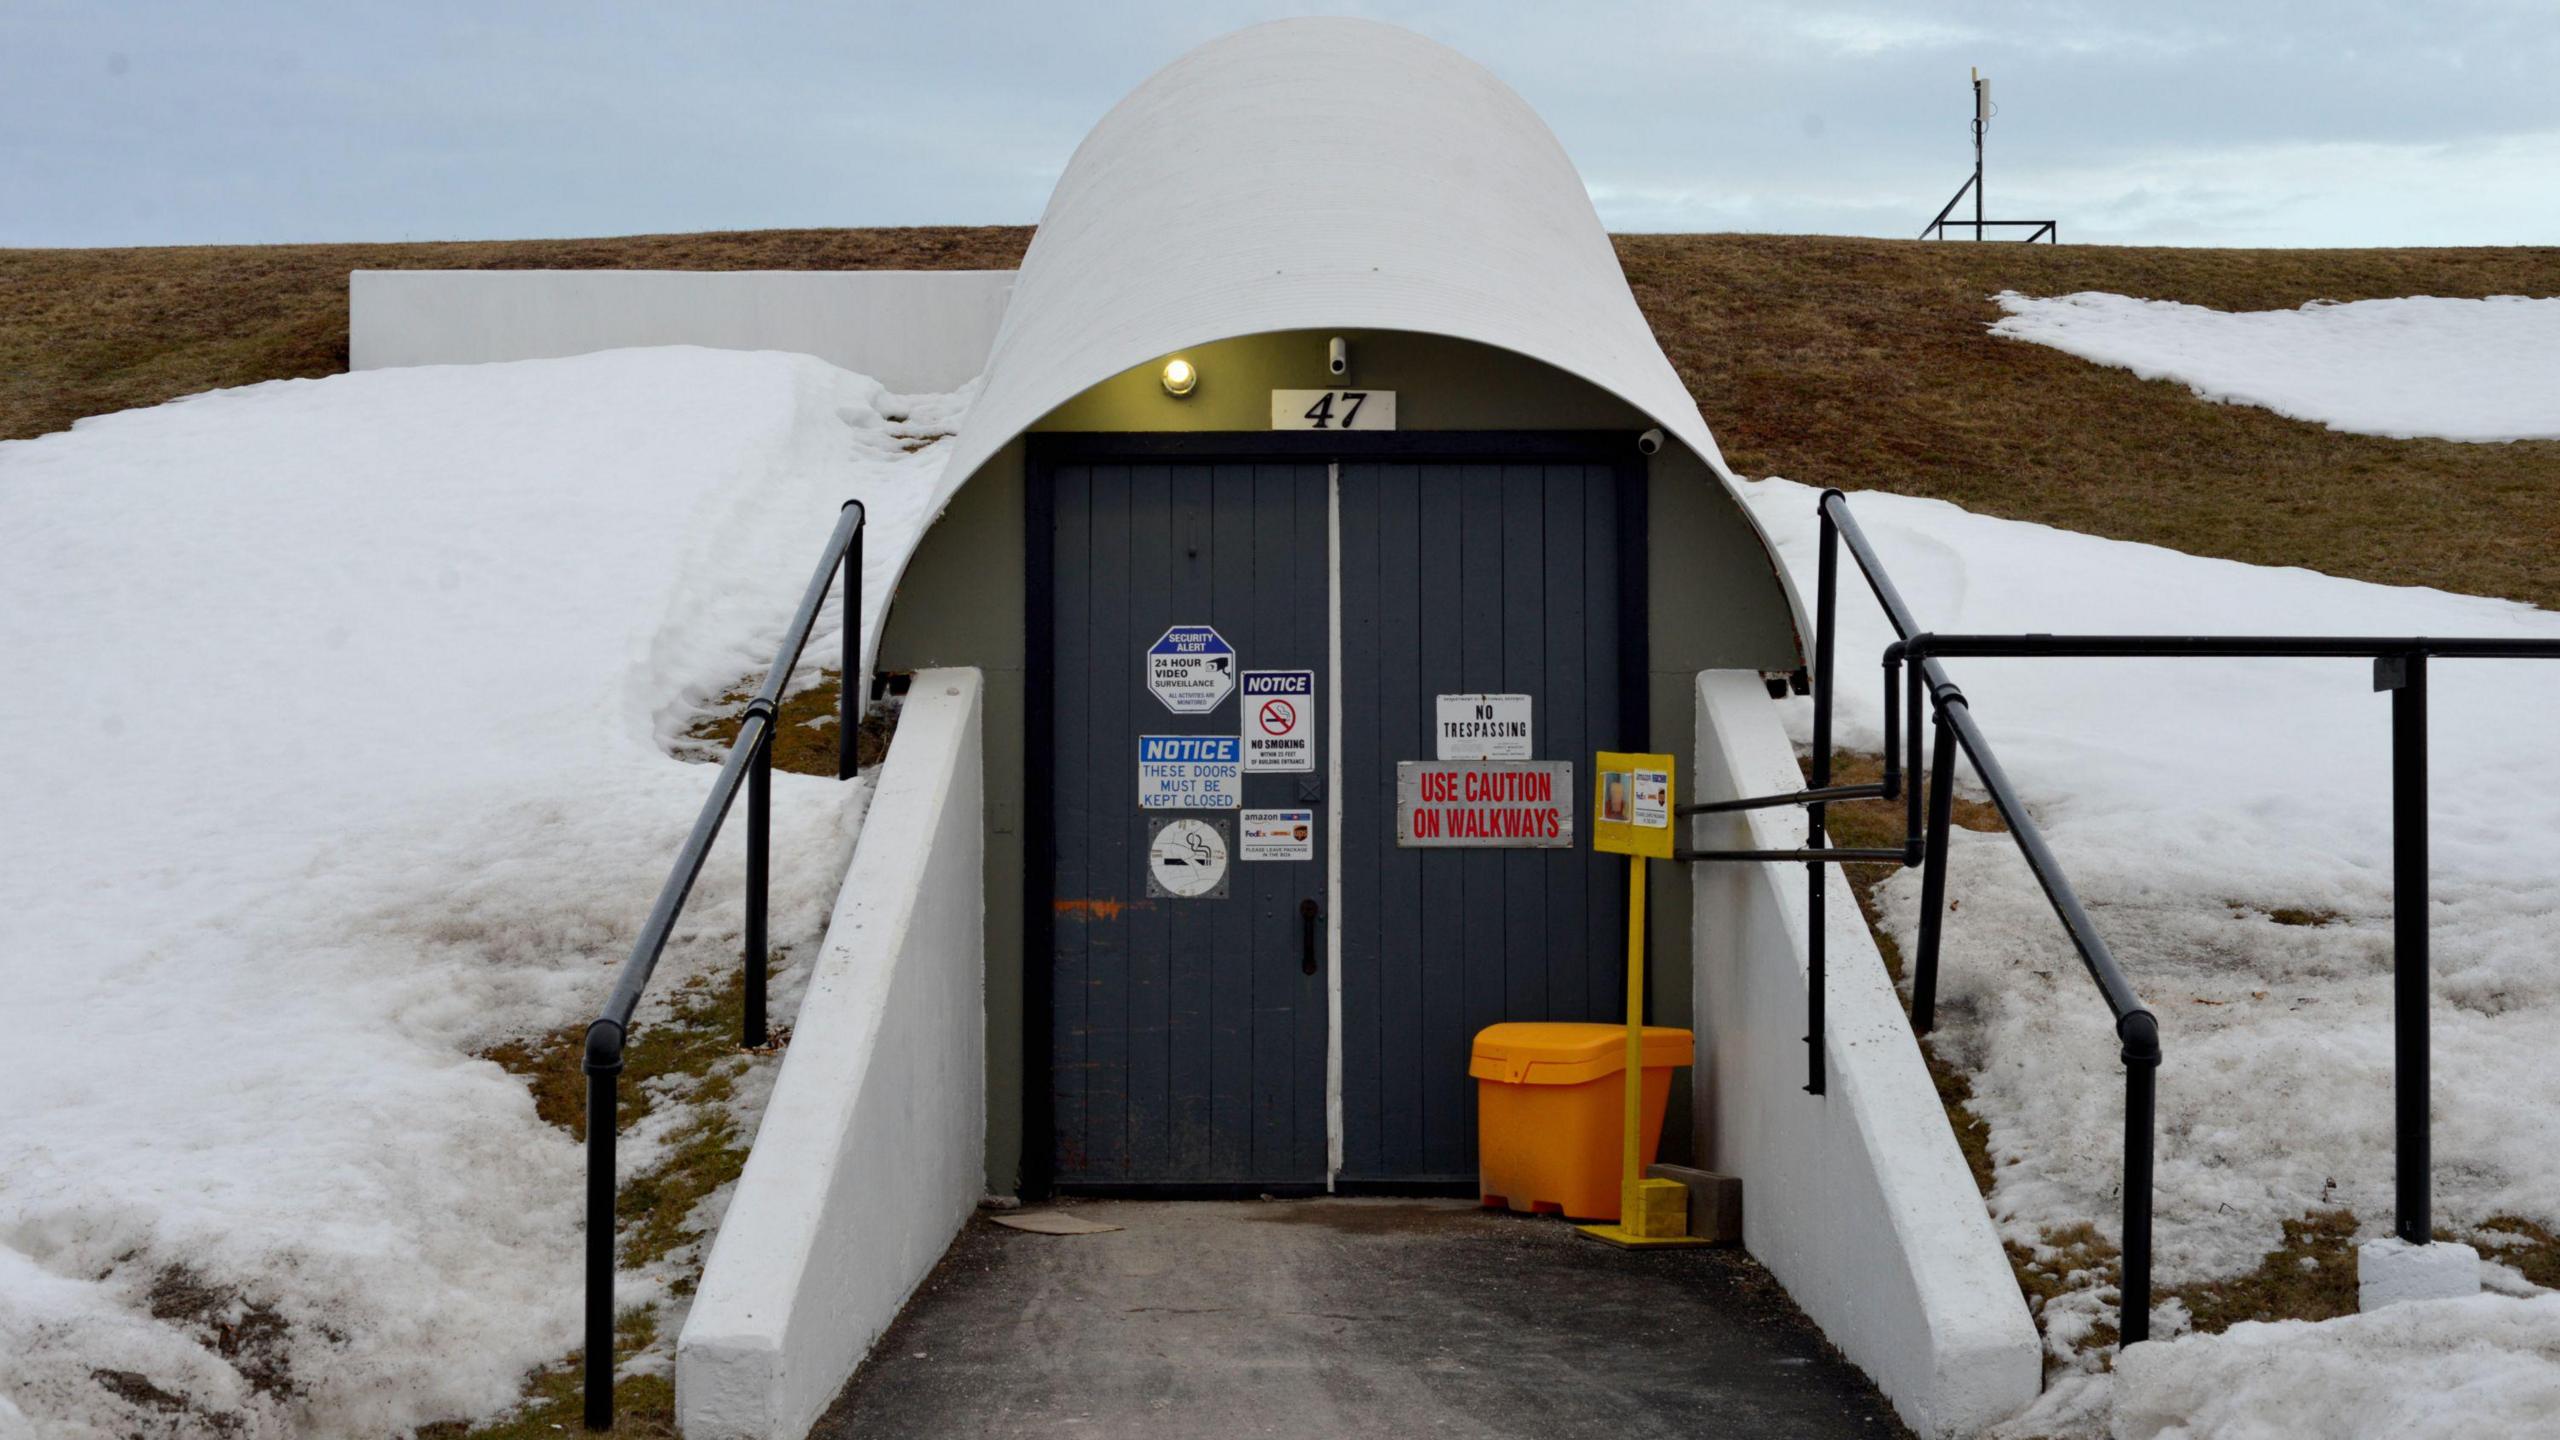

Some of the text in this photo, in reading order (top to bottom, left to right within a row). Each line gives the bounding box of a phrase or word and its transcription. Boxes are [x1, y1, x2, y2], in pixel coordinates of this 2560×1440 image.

[1304, 392, 1368, 428] 47
[1168, 633, 1214, 643] SECURITY
[1176, 643, 1206, 652] ALERT
[1155, 659, 1201, 668] 24 HOUR
[1155, 669, 1188, 678] VIDEO
[1247, 676, 1307, 692] NOTICE
[1476, 705, 1493, 720] NO
[1444, 722, 1526, 738] TRESPASSING
[1147, 740, 1233, 760] NOTICE
[1251, 739, 1305, 749] NO SMOKING
[1143, 765, 1237, 778] THESE DOORS
[1160, 780, 1221, 792] MUST BE
[1421, 772, 1552, 802] USE CAUTION
[1144, 794, 1233, 807] KEPT CLOSED
[1413, 808, 1560, 838] ON WALKWAYS
